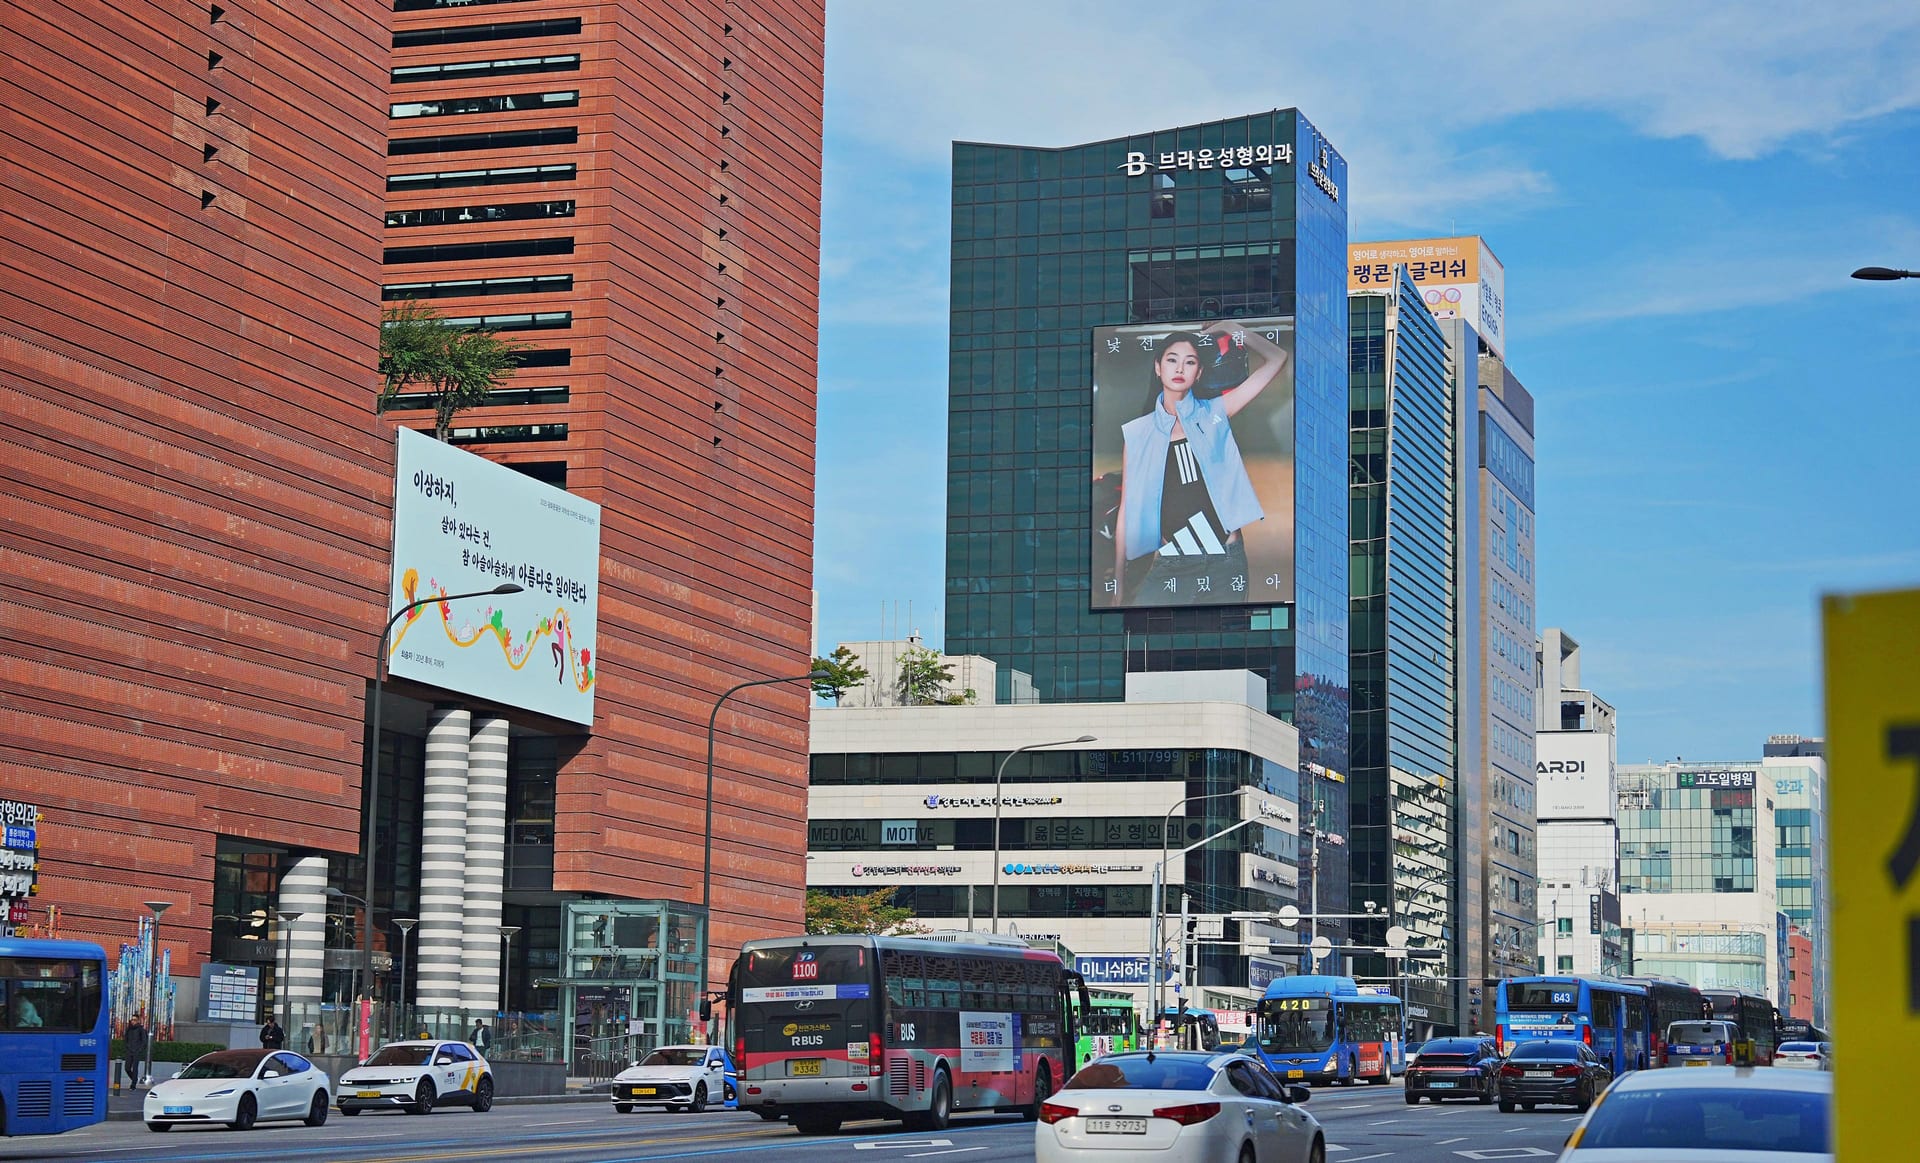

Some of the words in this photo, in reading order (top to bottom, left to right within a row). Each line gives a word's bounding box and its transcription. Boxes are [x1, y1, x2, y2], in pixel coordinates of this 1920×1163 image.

[1158, 143, 1293, 170] 브라운성형외과
[1353, 249, 1378, 261] 영어로
[1409, 246, 1434, 258] 영어로
[1353, 259, 1466, 284] 랭콘글리쉬
[413, 469, 457, 509] 이상하지,
[441, 515, 457, 536] 살아
[458, 522, 481, 545] 있다는
[483, 530, 492, 550] 건,
[462, 548, 470, 567] 참
[471, 552, 516, 582] 아슬아슬하게
[518, 563, 553, 594] 아름다운
[555, 576, 587, 605] 일이란다
[1104, 579, 1118, 595] 더
[1536, 761, 1585, 773] ARDI
[1695, 772, 1753, 786] 고도일병원
[1775, 779, 1803, 795] 안과
[811, 827, 868, 842] MEDICAL
[886, 827, 934, 842] MOTIVE
[1108, 823, 1180, 841] 성형외과
[793, 963, 817, 978] 1100
[1281, 1000, 1310, 1010] 420
[1554, 993, 1570, 1003] 643
[1215, 1011, 1245, 1024] 미동맹
[799, 1065, 819, 1074] 3343
[1115, 1120, 1141, 1131] 9973
